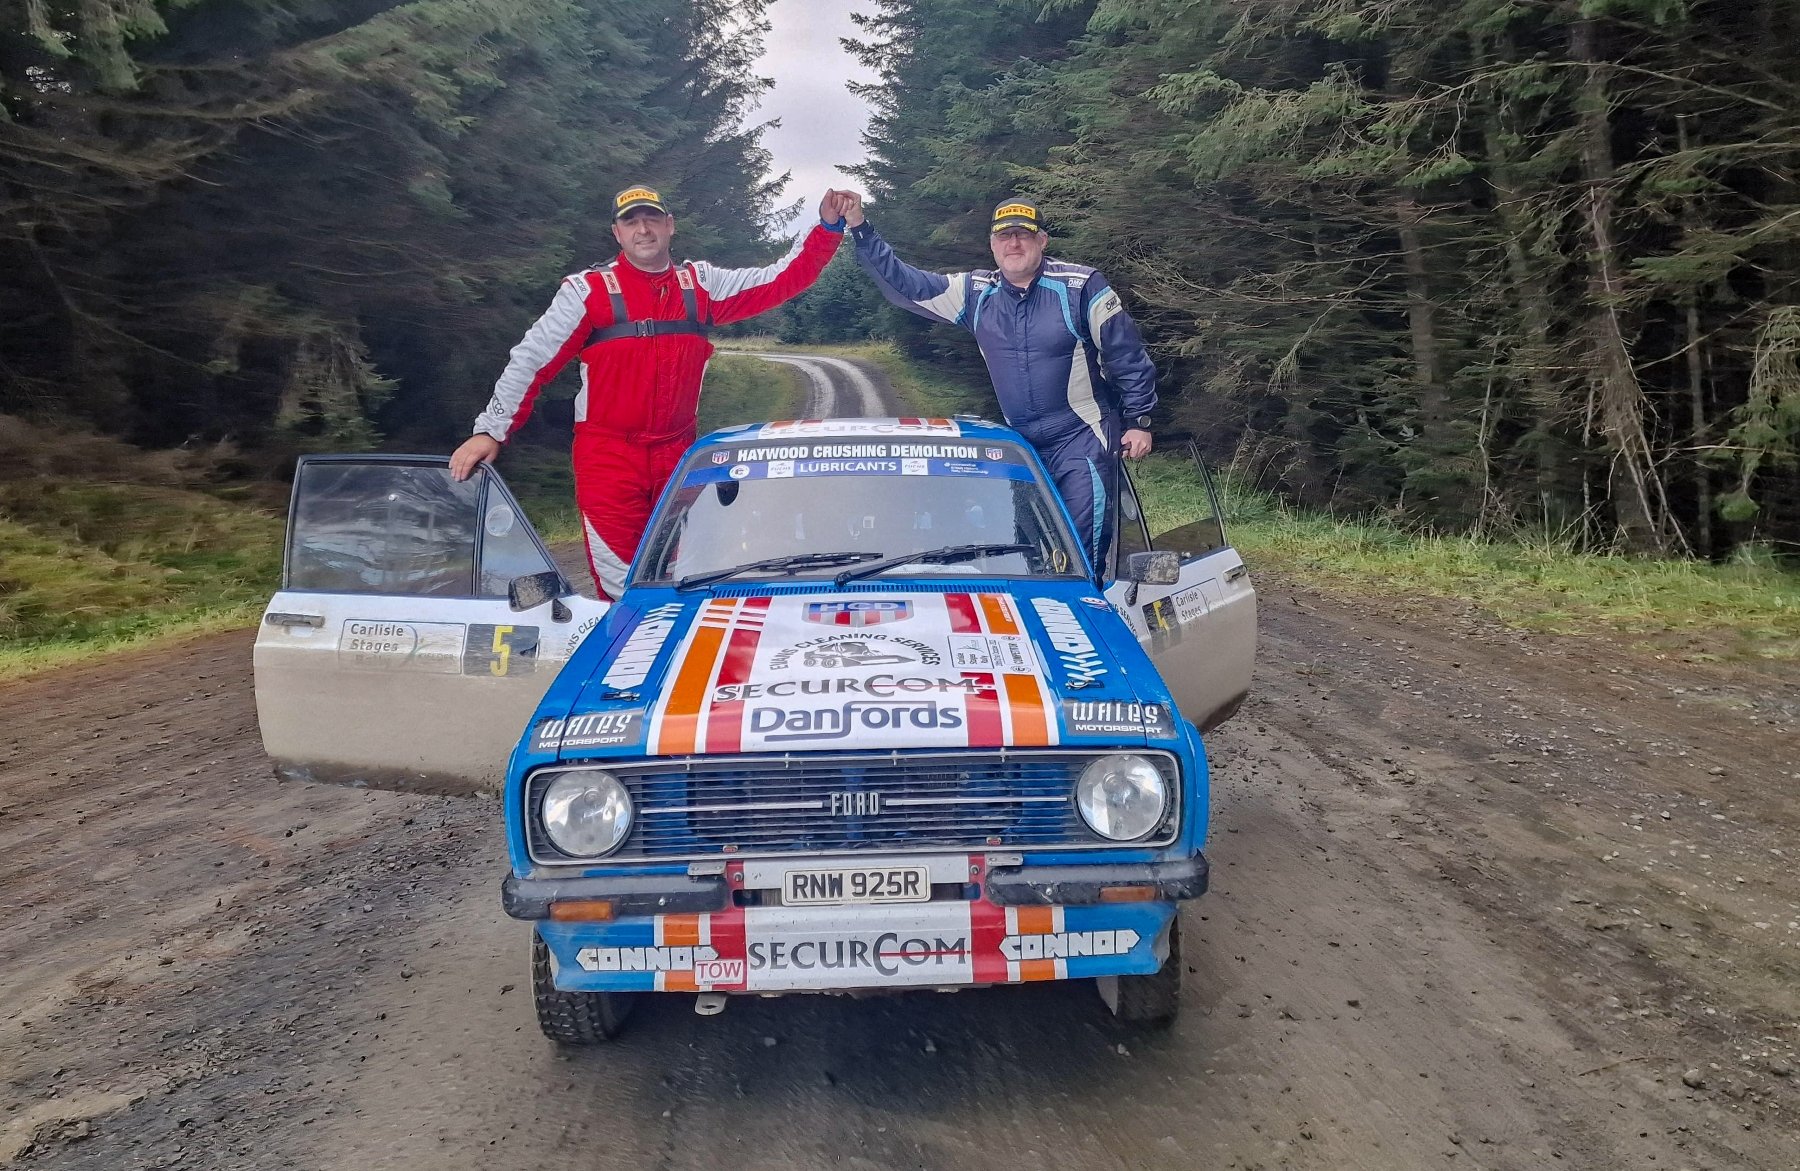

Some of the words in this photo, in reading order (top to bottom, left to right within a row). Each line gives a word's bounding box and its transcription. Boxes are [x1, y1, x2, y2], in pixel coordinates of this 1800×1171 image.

[737, 446, 809, 462] HAYWOOD
[813, 445, 887, 458] CRUSHING
[891, 445, 978, 459] DEMOLITION
[800, 461, 897, 473] LUBRICANTS
[820, 602, 899, 611] HCD
[1175, 591, 1199, 607] Carlisle
[350, 623, 404, 637] Carlisle
[350, 639, 399, 654] Stages
[490, 626, 514, 677] 5
[769, 648, 799, 671] EVANS
[794, 633, 888, 649] CLEANING
[890, 637, 941, 667] SERVICES
[750, 701, 963, 742] Danfords
[1075, 724, 1162, 734] MOTORSPORT
[538, 736, 626, 749] MOTORSPORT
[831, 792, 879, 817] FORD
[792, 873, 843, 899] RNW
[850, 871, 920, 898] 925R
[998, 929, 1141, 961] CONNOP
[748, 932, 966, 976] SECURCOM
[697, 962, 741, 979] TOW
